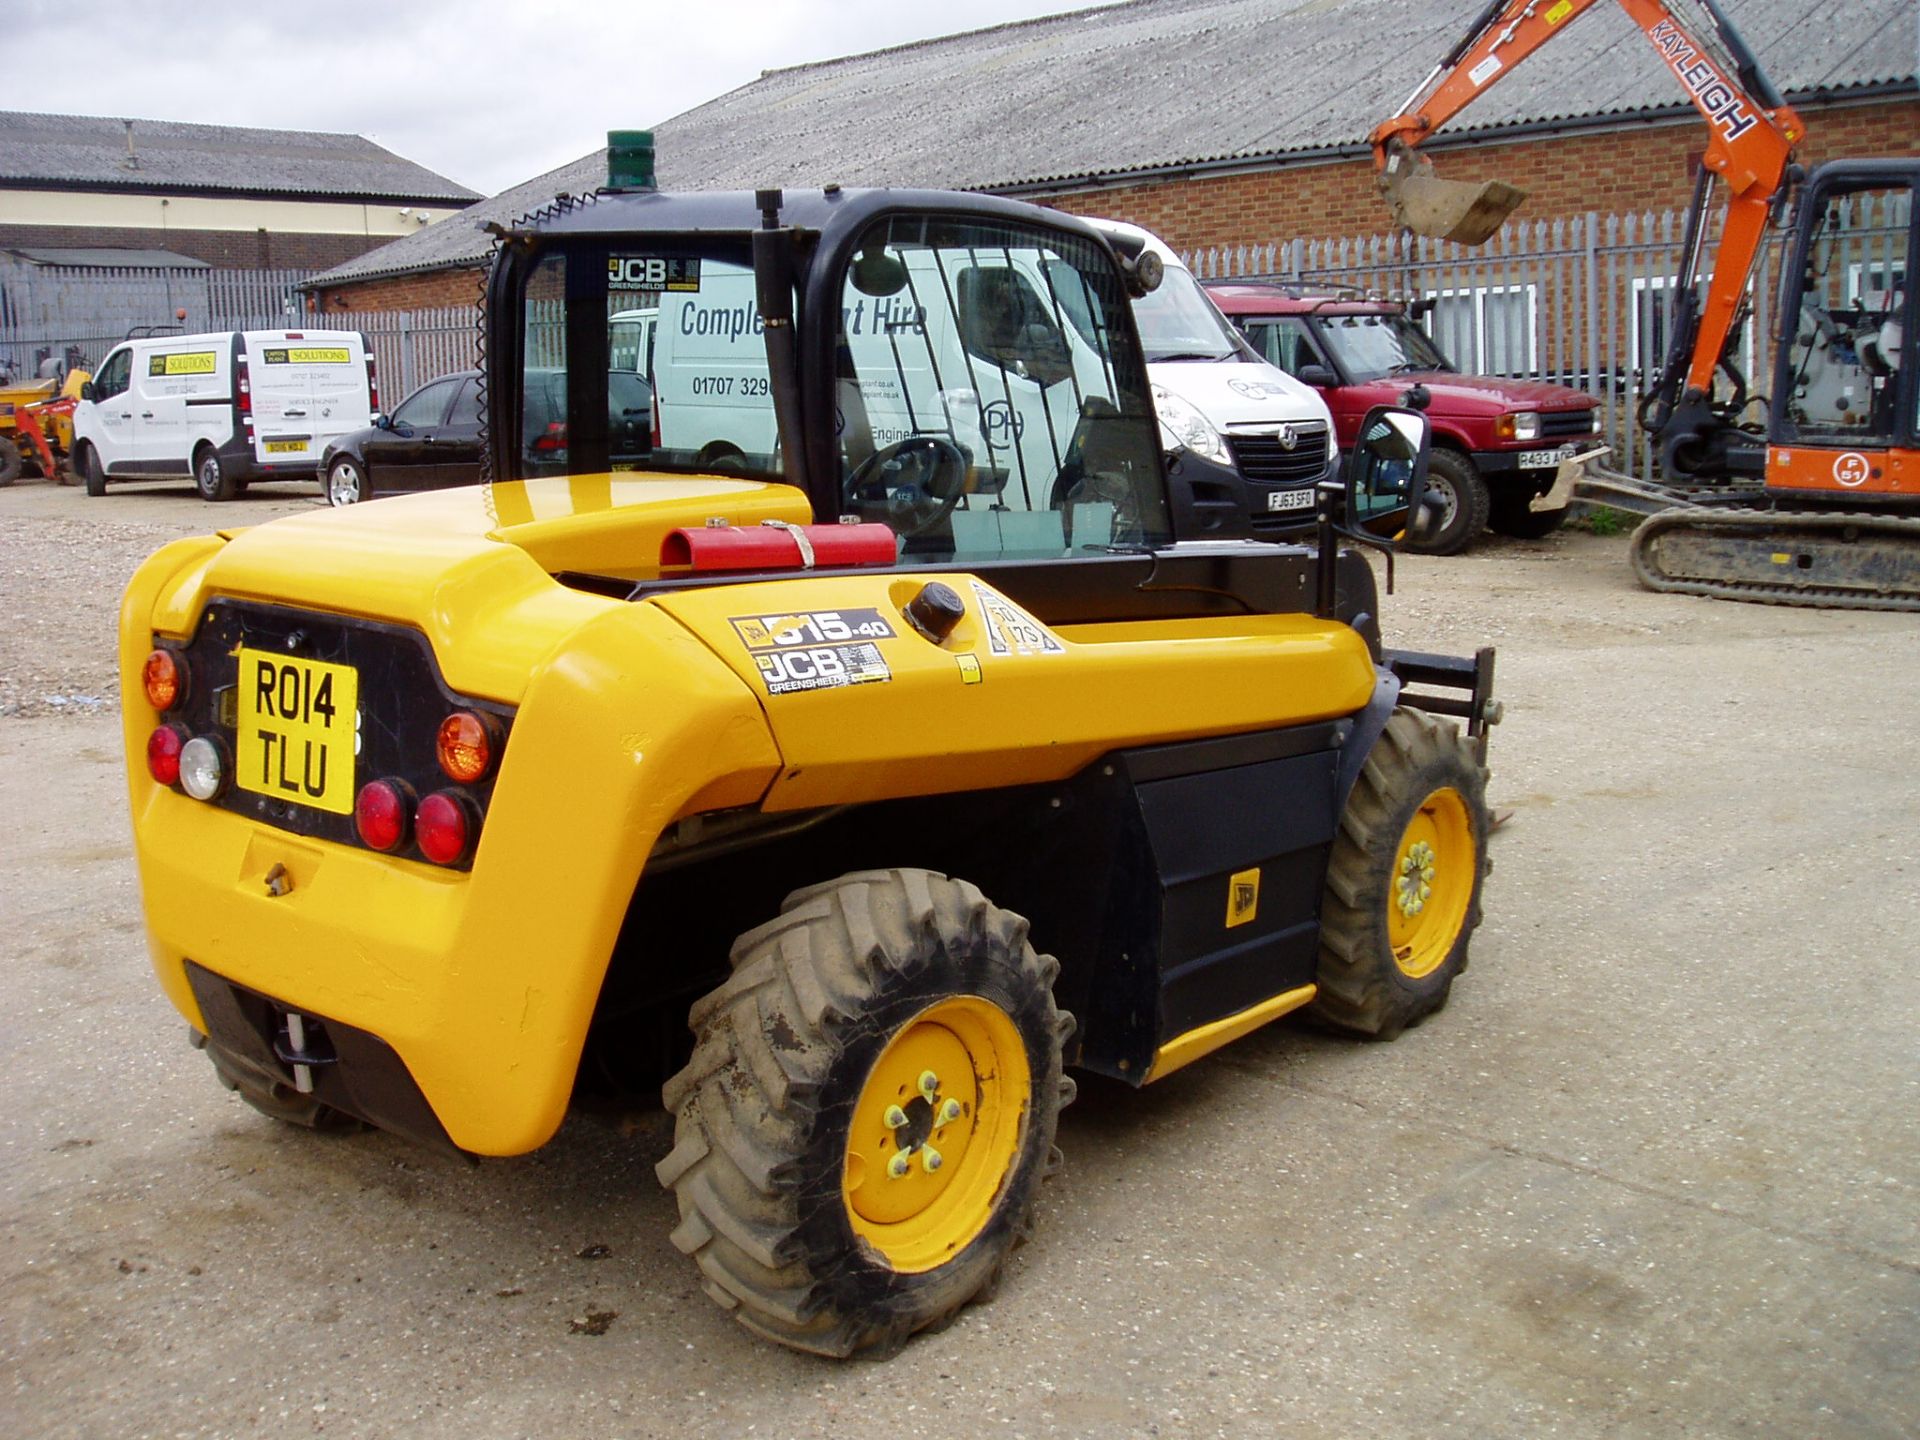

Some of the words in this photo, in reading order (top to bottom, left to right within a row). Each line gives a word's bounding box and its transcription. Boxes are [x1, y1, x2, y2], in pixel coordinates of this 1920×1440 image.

[1649, 19, 1758, 143] KAYLEIGH
[608, 259, 666, 282] JCB
[608, 282, 665, 290] GREENSHIELDS
[681, 300, 764, 343] Comple
[872, 297, 928, 335] Hire
[292, 350, 346, 361] SOLUTIONS
[693, 376, 734, 395] 01707
[740, 377, 773, 396] 329
[762, 648, 846, 682] JCB
[256, 660, 336, 728] RO14
[257, 728, 327, 798] TLU
